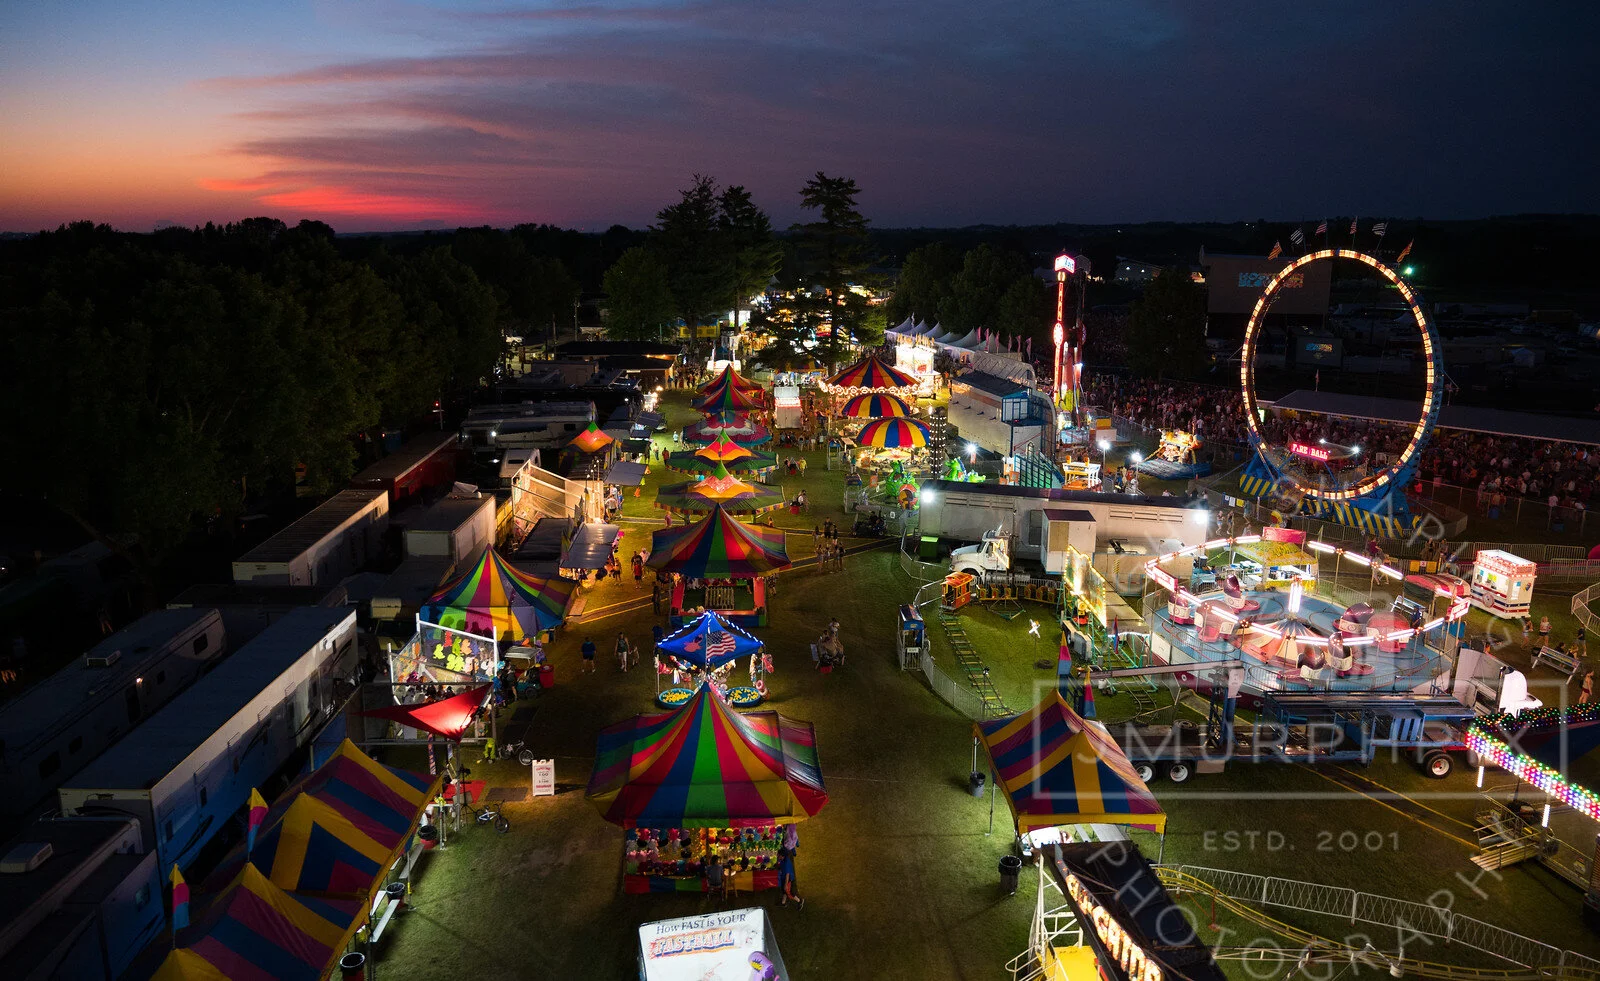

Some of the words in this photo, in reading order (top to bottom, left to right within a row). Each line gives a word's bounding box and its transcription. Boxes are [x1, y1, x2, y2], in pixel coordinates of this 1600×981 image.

[1311, 448, 1328, 459] BALL
[681, 919, 704, 931] FAST
[706, 919, 715, 927] is
[716, 913, 747, 926] YOUR
[654, 930, 735, 957] FASTBALL
